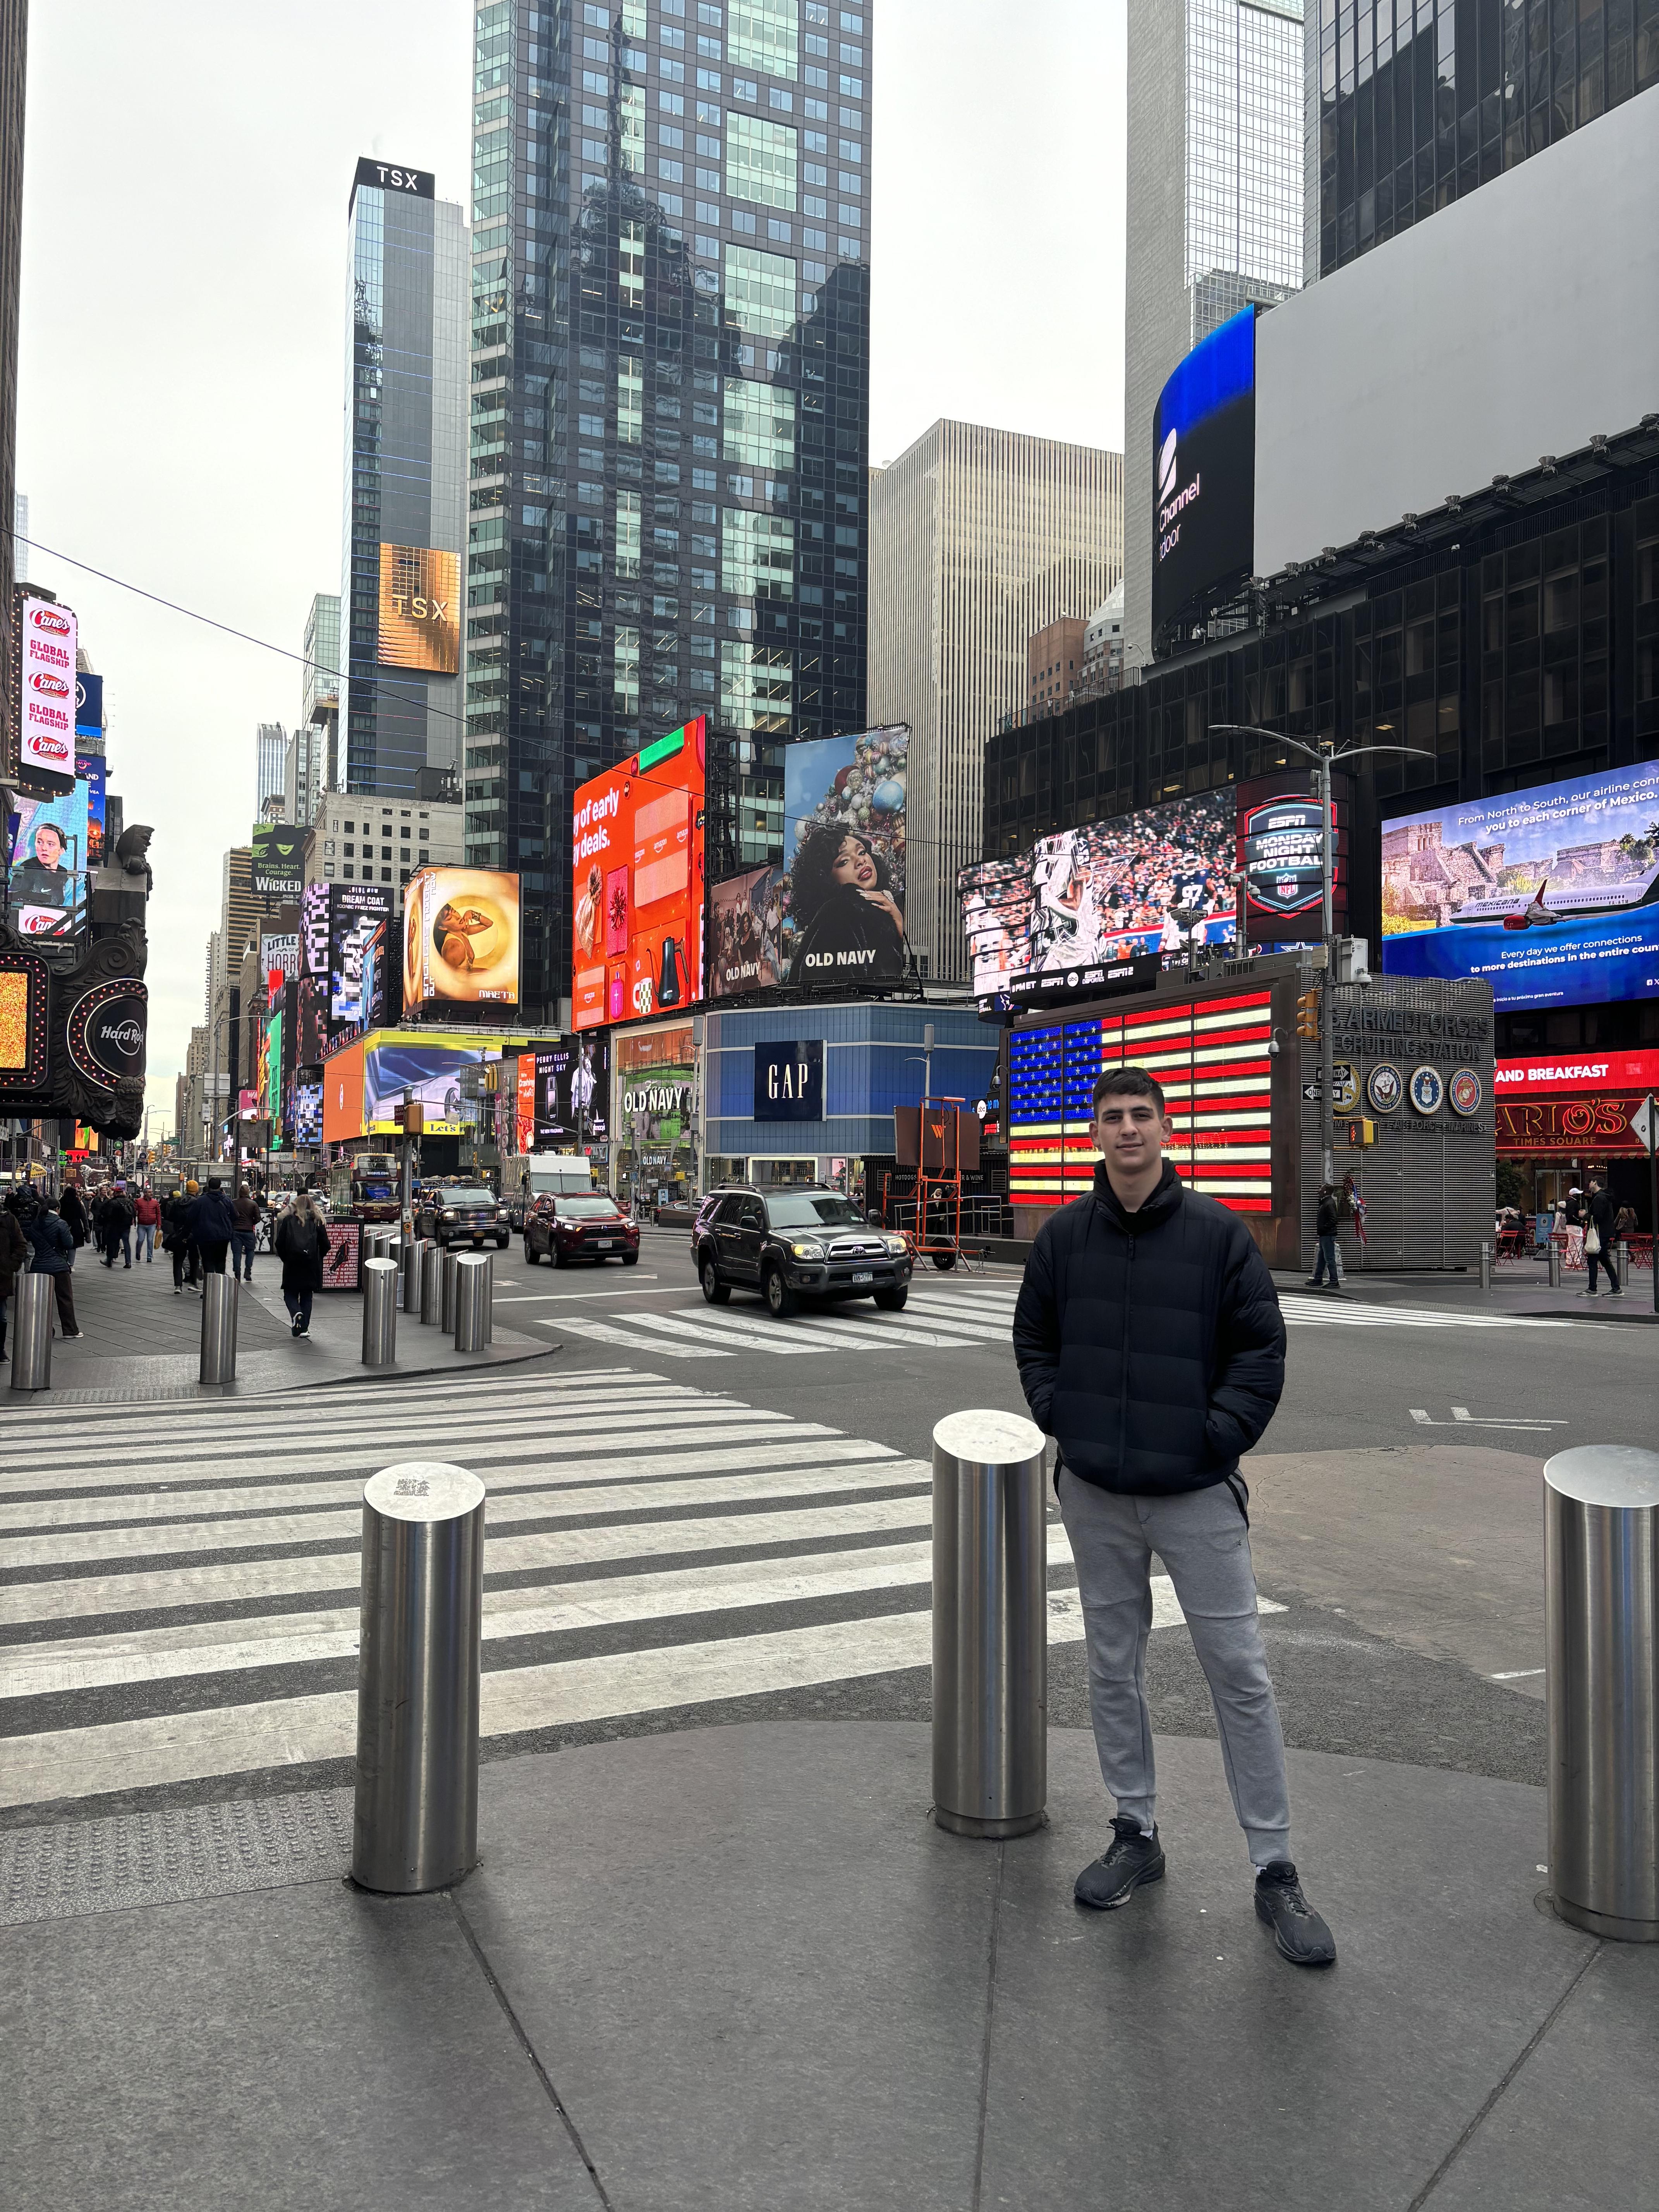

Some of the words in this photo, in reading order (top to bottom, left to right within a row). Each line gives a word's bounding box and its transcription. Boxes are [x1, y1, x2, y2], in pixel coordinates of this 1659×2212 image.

[377, 166, 417, 191] TSX
[1160, 473, 1200, 532] Channel
[392, 594, 448, 622] TSX
[31, 608, 70, 630] Cane's
[30, 639, 69, 660] GLOBAL
[30, 649, 69, 668] FLAGSHIP
[30, 671, 69, 691] Cane's
[29, 703, 68, 722] GLOBAL
[29, 713, 69, 730] FLAGSHIP
[29, 735, 68, 754] Cane's
[581, 799, 592, 828] of
[592, 787, 619, 817] early
[1458, 814, 1484, 826] From
[1487, 807, 1517, 819] North
[1520, 803, 1531, 813] to
[1534, 796, 1568, 810] South,
[1571, 791, 1590, 801] our
[1593, 783, 1630, 797] airline
[1486, 821, 1506, 835] you
[1509, 818, 1520, 828] to
[1522, 811, 1549, 825] each
[1553, 804, 1592, 819] corner
[1594, 798, 1607, 810] of
[1610, 790, 1658, 807] Mexico.
[1268, 815, 1306, 829] ESPN
[581, 824, 610, 859] deals.
[1256, 833, 1323, 850] MONDAY
[1264, 844, 1314, 858] NIGHT
[1249, 855, 1323, 872] FOOTBAL
[1182, 884, 1203, 898] 97
[1281, 884, 1295, 894] NFL
[342, 894, 365, 904] DREAM
[367, 896, 385, 905] COAT
[1475, 898, 1520, 908] mexicana
[268, 936, 296, 951] LITTLE
[1501, 950, 1525, 959] Every
[1527, 948, 1543, 957] day
[1560, 943, 1581, 951] offer
[1583, 935, 1642, 949] connections
[805, 953, 833, 967] OLD
[837, 950, 876, 965] NAVY
[1482, 963, 1505, 972] more
[1508, 955, 1566, 969] destinations
[1568, 953, 1577, 962] in
[1579, 950, 1596, 960] the
[1599, 947, 1629, 958] entire
[726, 967, 739, 981] OLD
[741, 962, 760, 978] NAVY
[1085, 970, 1103, 978] ESPN
[1108, 966, 1134, 979] ESPN2
[1027, 981, 1037, 990] ET
[1041, 977, 1064, 988] ESPN
[1082, 976, 1105, 985] DEPORTES
[479, 990, 515, 1000] MAETA
[1347, 1007, 1417, 1032] ARMED
[1419, 1013, 1489, 1038] FORCES
[101, 1025, 131, 1040] Hard
[1333, 1034, 1416, 1056] ECRUITING
[1420, 1040, 1482, 1060] STATION
[536, 1055, 552, 1064] PERRY
[554, 1053, 569, 1061] ELLIS
[539, 1065, 554, 1074] NIGHT
[1496, 1070, 1524, 1082] AND
[1528, 1064, 1609, 1080] BREAKFAST
[768, 1063, 808, 1099] GAP
[625, 1091, 647, 1113] OLD
[649, 1087, 683, 1111] NAVY
[1495, 1097, 1627, 1137] ARLO'S
[431, 1124, 456, 1132] Let's
[1411, 1120, 1438, 1130] FORCE
[1448, 1121, 1483, 1132] MARINES
[1513, 1138, 1546, 1147] TIMES
[1550, 1137, 1596, 1146] SQUARE
[643, 1156, 653, 1165] OLD
[653, 1156, 667, 1165] NAVY
